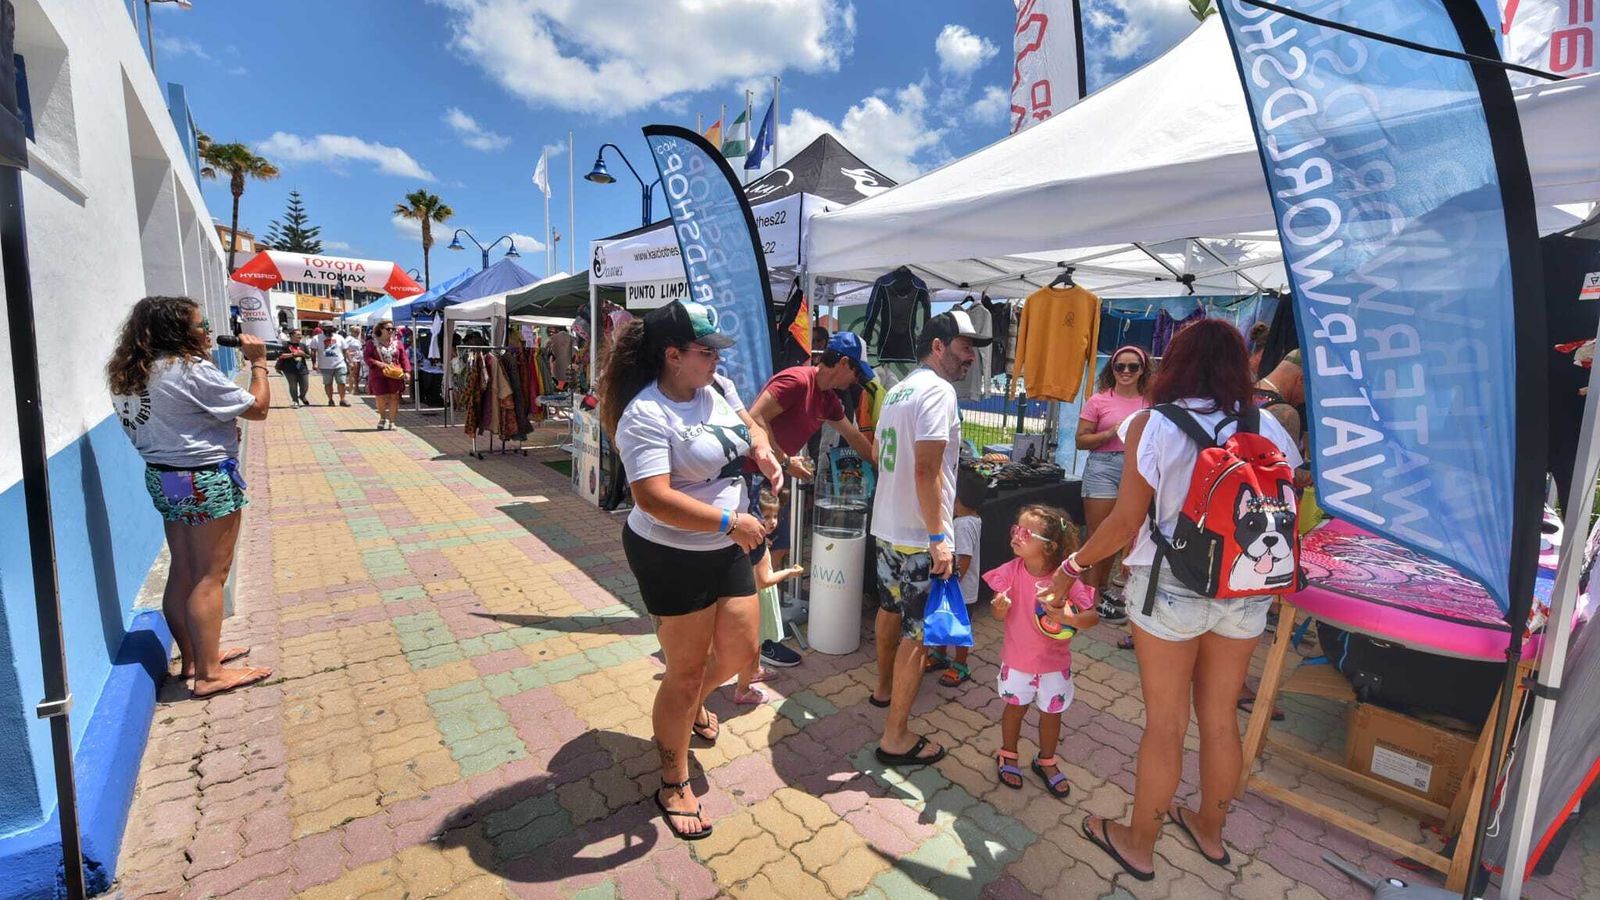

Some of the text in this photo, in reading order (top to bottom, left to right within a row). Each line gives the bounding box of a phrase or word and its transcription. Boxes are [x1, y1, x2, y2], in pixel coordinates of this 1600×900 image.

[302, 257, 366, 272] TOYOTA
[303, 269, 366, 283] A. TOMAX
[629, 282, 688, 300] PUNTO LIMPI
